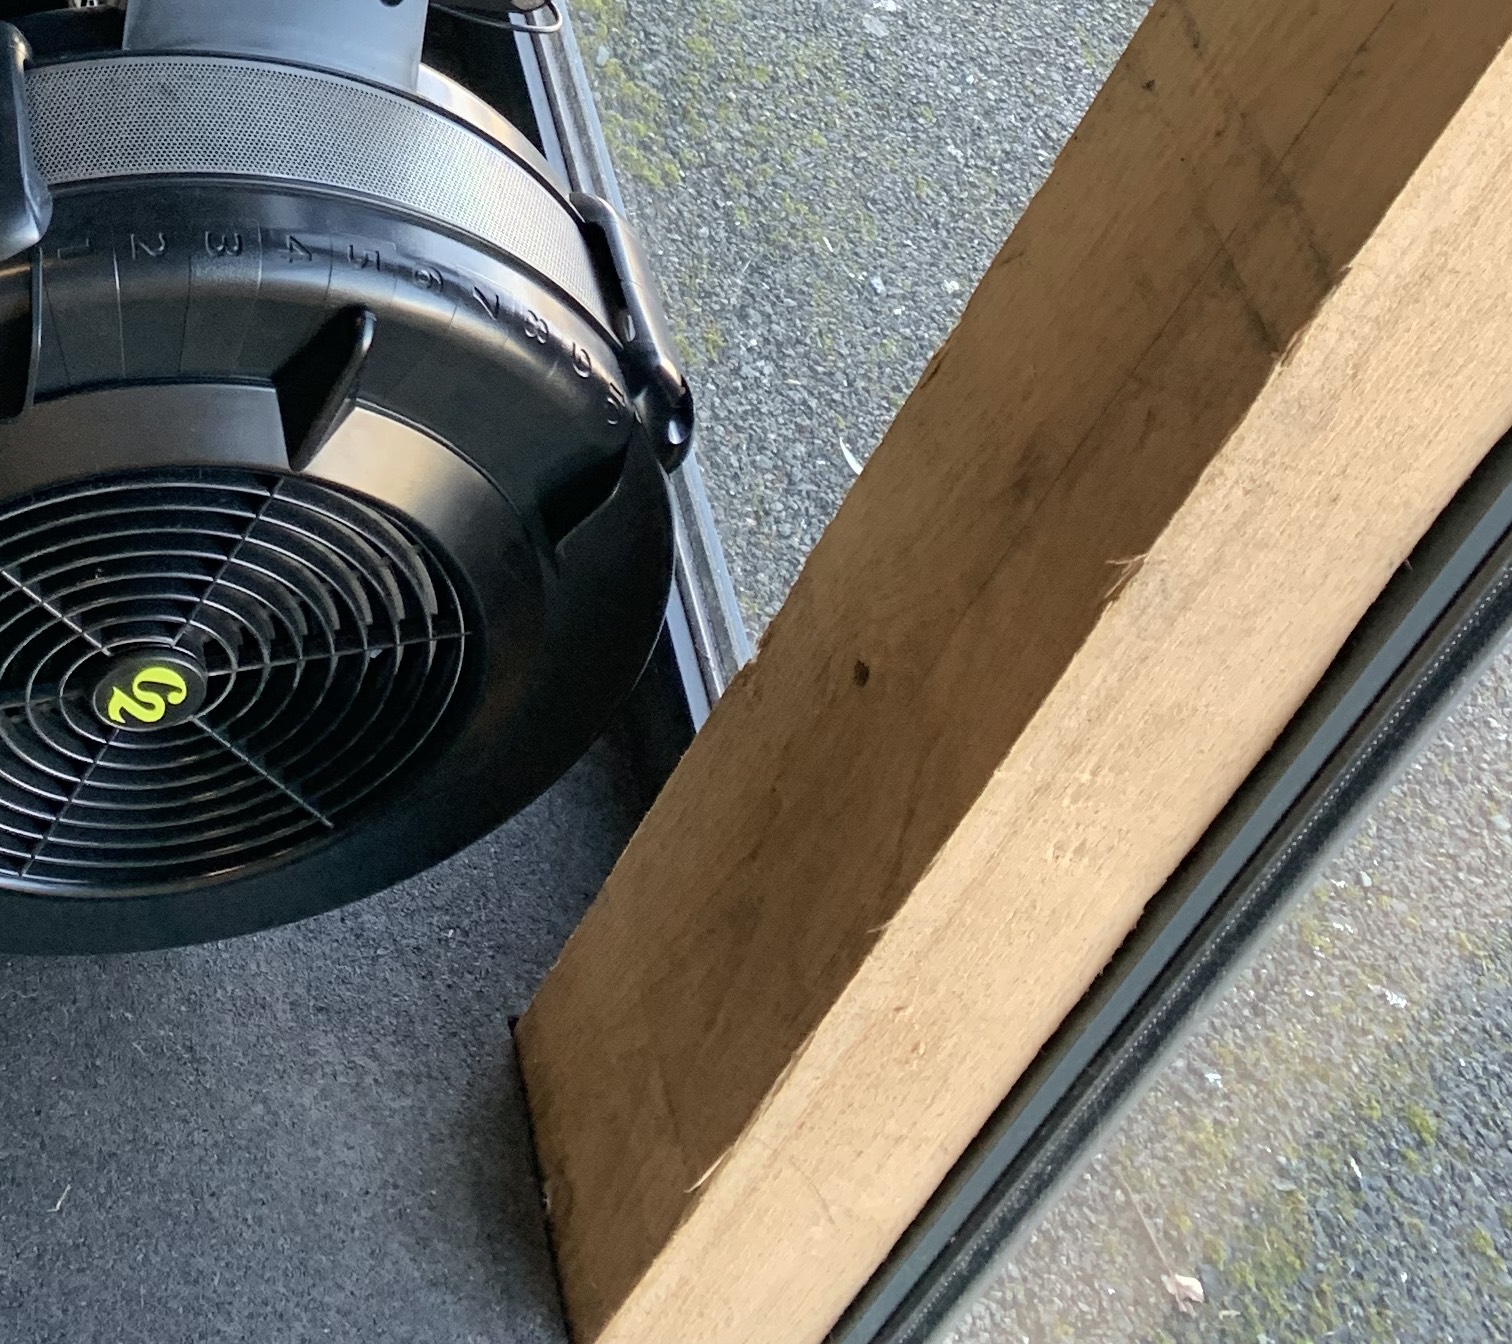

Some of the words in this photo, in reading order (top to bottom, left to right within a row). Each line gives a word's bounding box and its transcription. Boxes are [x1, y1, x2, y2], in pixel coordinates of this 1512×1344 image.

[130, 231, 168, 261] 2
[204, 229, 243, 258] 3
[284, 233, 313, 264] 4
[347, 244, 381, 272] 5
[472, 286, 501, 322] 7
[523, 309, 550, 345] 8
[572, 342, 593, 379] 9
